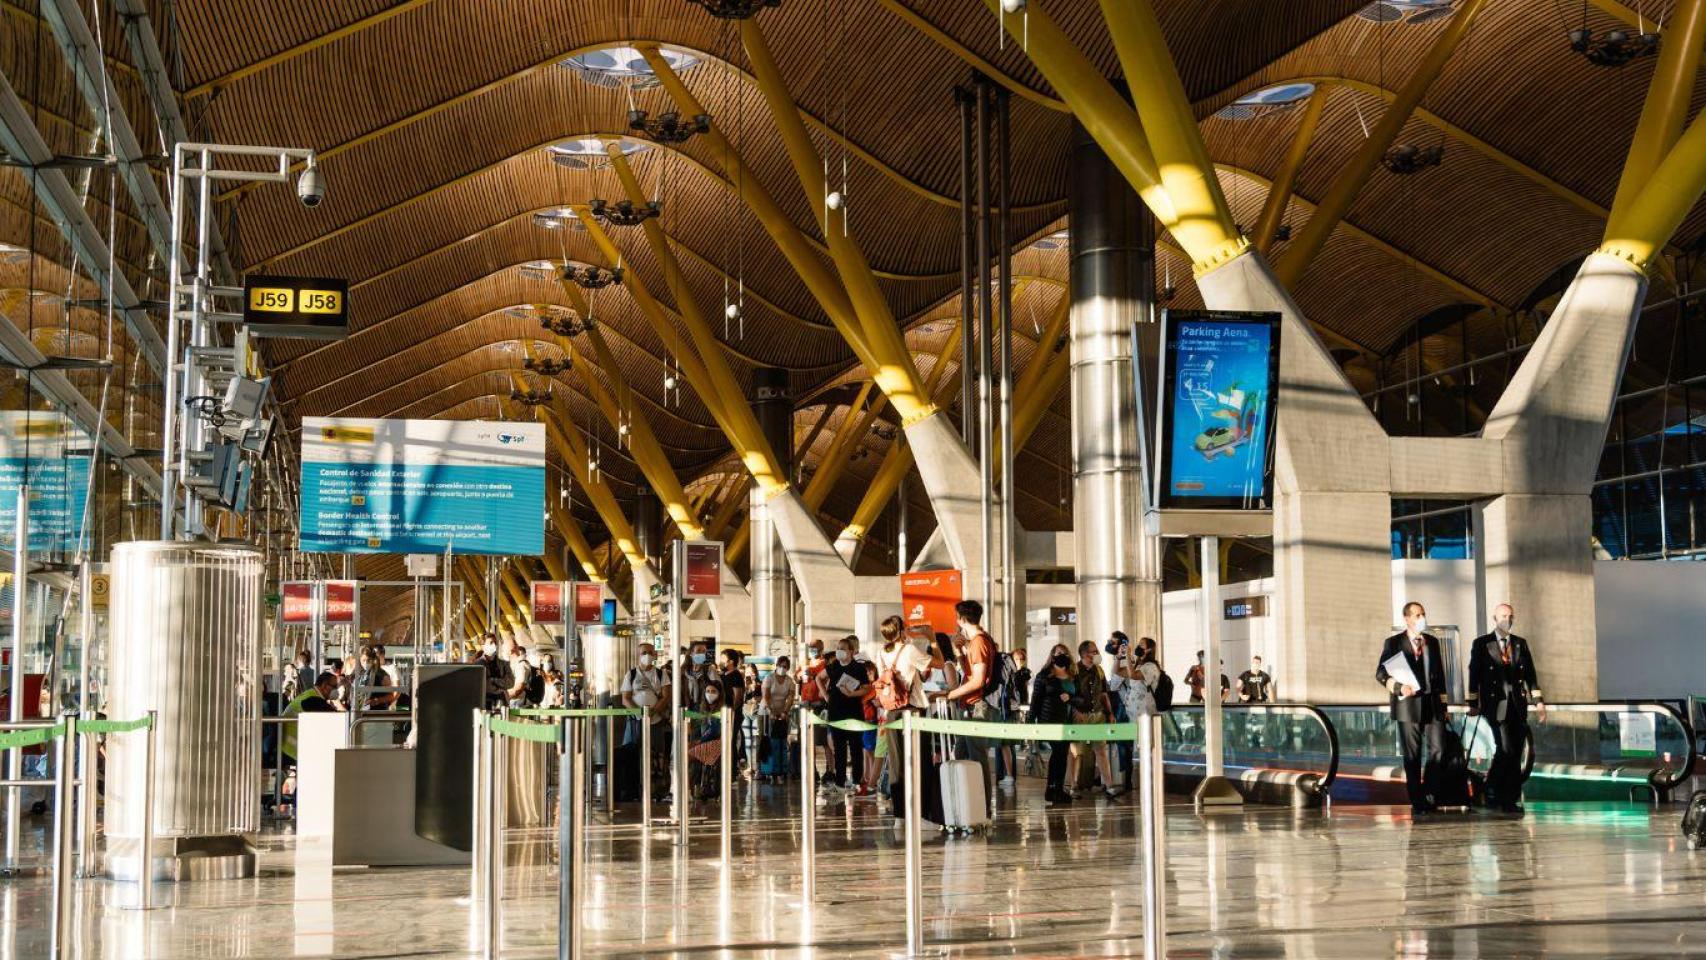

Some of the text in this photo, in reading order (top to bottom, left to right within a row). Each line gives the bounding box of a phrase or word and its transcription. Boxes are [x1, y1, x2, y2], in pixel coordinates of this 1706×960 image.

[255, 292, 336, 310] J59 J58
[1182, 326, 1249, 339] Parking Aena
[349, 469, 359, 477] de
[360, 469, 391, 477] Sanidad
[372, 513, 400, 521] Control
[97, 582, 103, 591] 3
